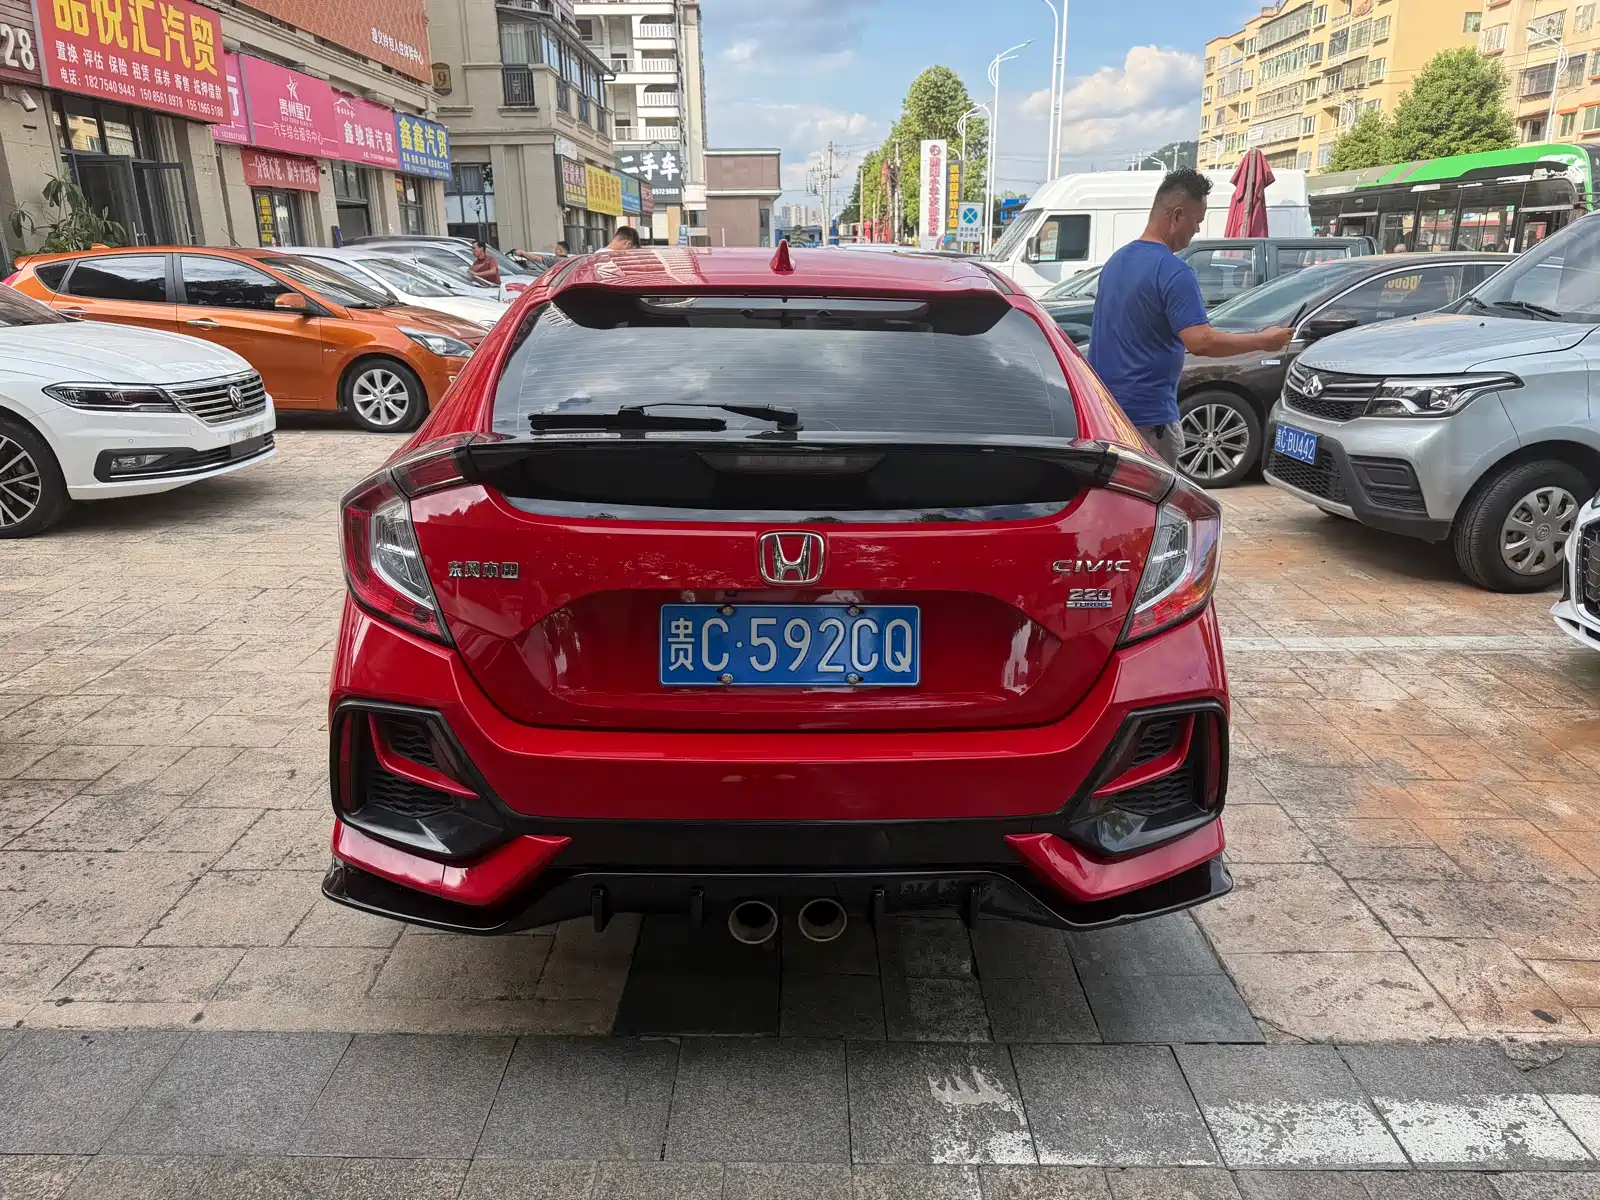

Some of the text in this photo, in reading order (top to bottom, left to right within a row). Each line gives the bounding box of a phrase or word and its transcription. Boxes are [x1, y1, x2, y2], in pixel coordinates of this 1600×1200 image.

[53, 0, 218, 76] 品悦汇汽贸
[55, 40, 79, 64] 置换
[83, 47, 104, 70] 评估
[108, 54, 129, 77] 保险
[131, 61, 151, 82] 租赁
[154, 67, 171, 88] 保养
[174, 73, 190, 92] 寄售
[193, 78, 223, 100] 抵押借款
[279, 98, 312, 121] 贵州星亿
[273, 121, 323, 145] 汽车综合服务中心
[399, 117, 448, 159] 鑫鑫汽贸
[621, 152, 679, 181] 二手车
[448, 560, 519, 578] 东风本田
[1052, 559, 1131, 573] CIVIC
[1068, 588, 1112, 601] 220
[667, 617, 913, 673] 贵C·592CQ
